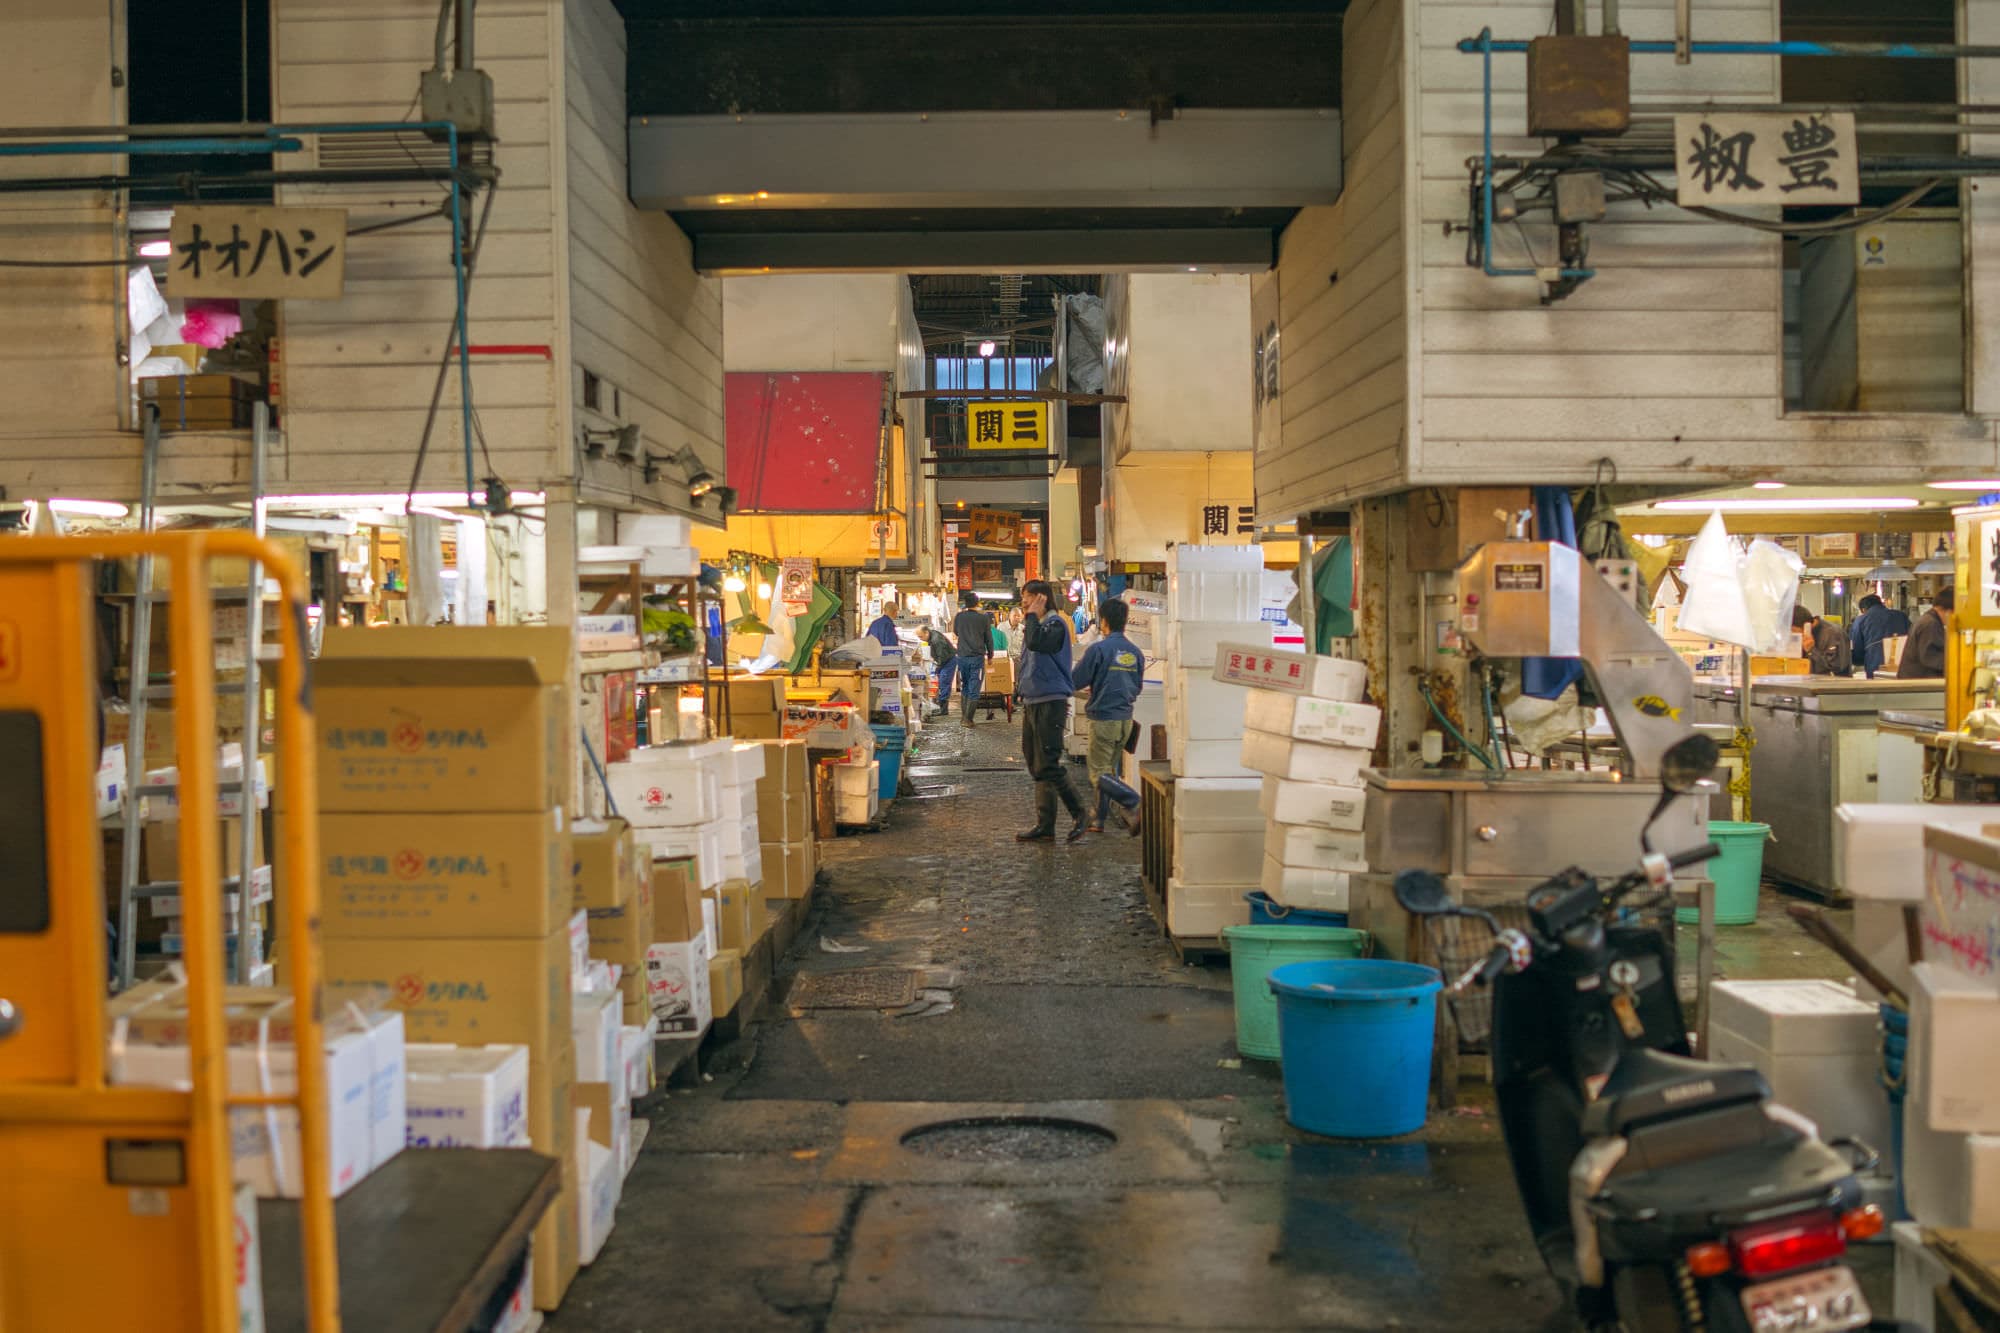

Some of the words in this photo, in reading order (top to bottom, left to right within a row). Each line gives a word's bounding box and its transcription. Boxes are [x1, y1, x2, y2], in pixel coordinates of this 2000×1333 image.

[177, 223, 336, 280] オオハシ
[974, 409, 1039, 444] 関三
[1664, 1080, 1716, 1104] YAMAHA
